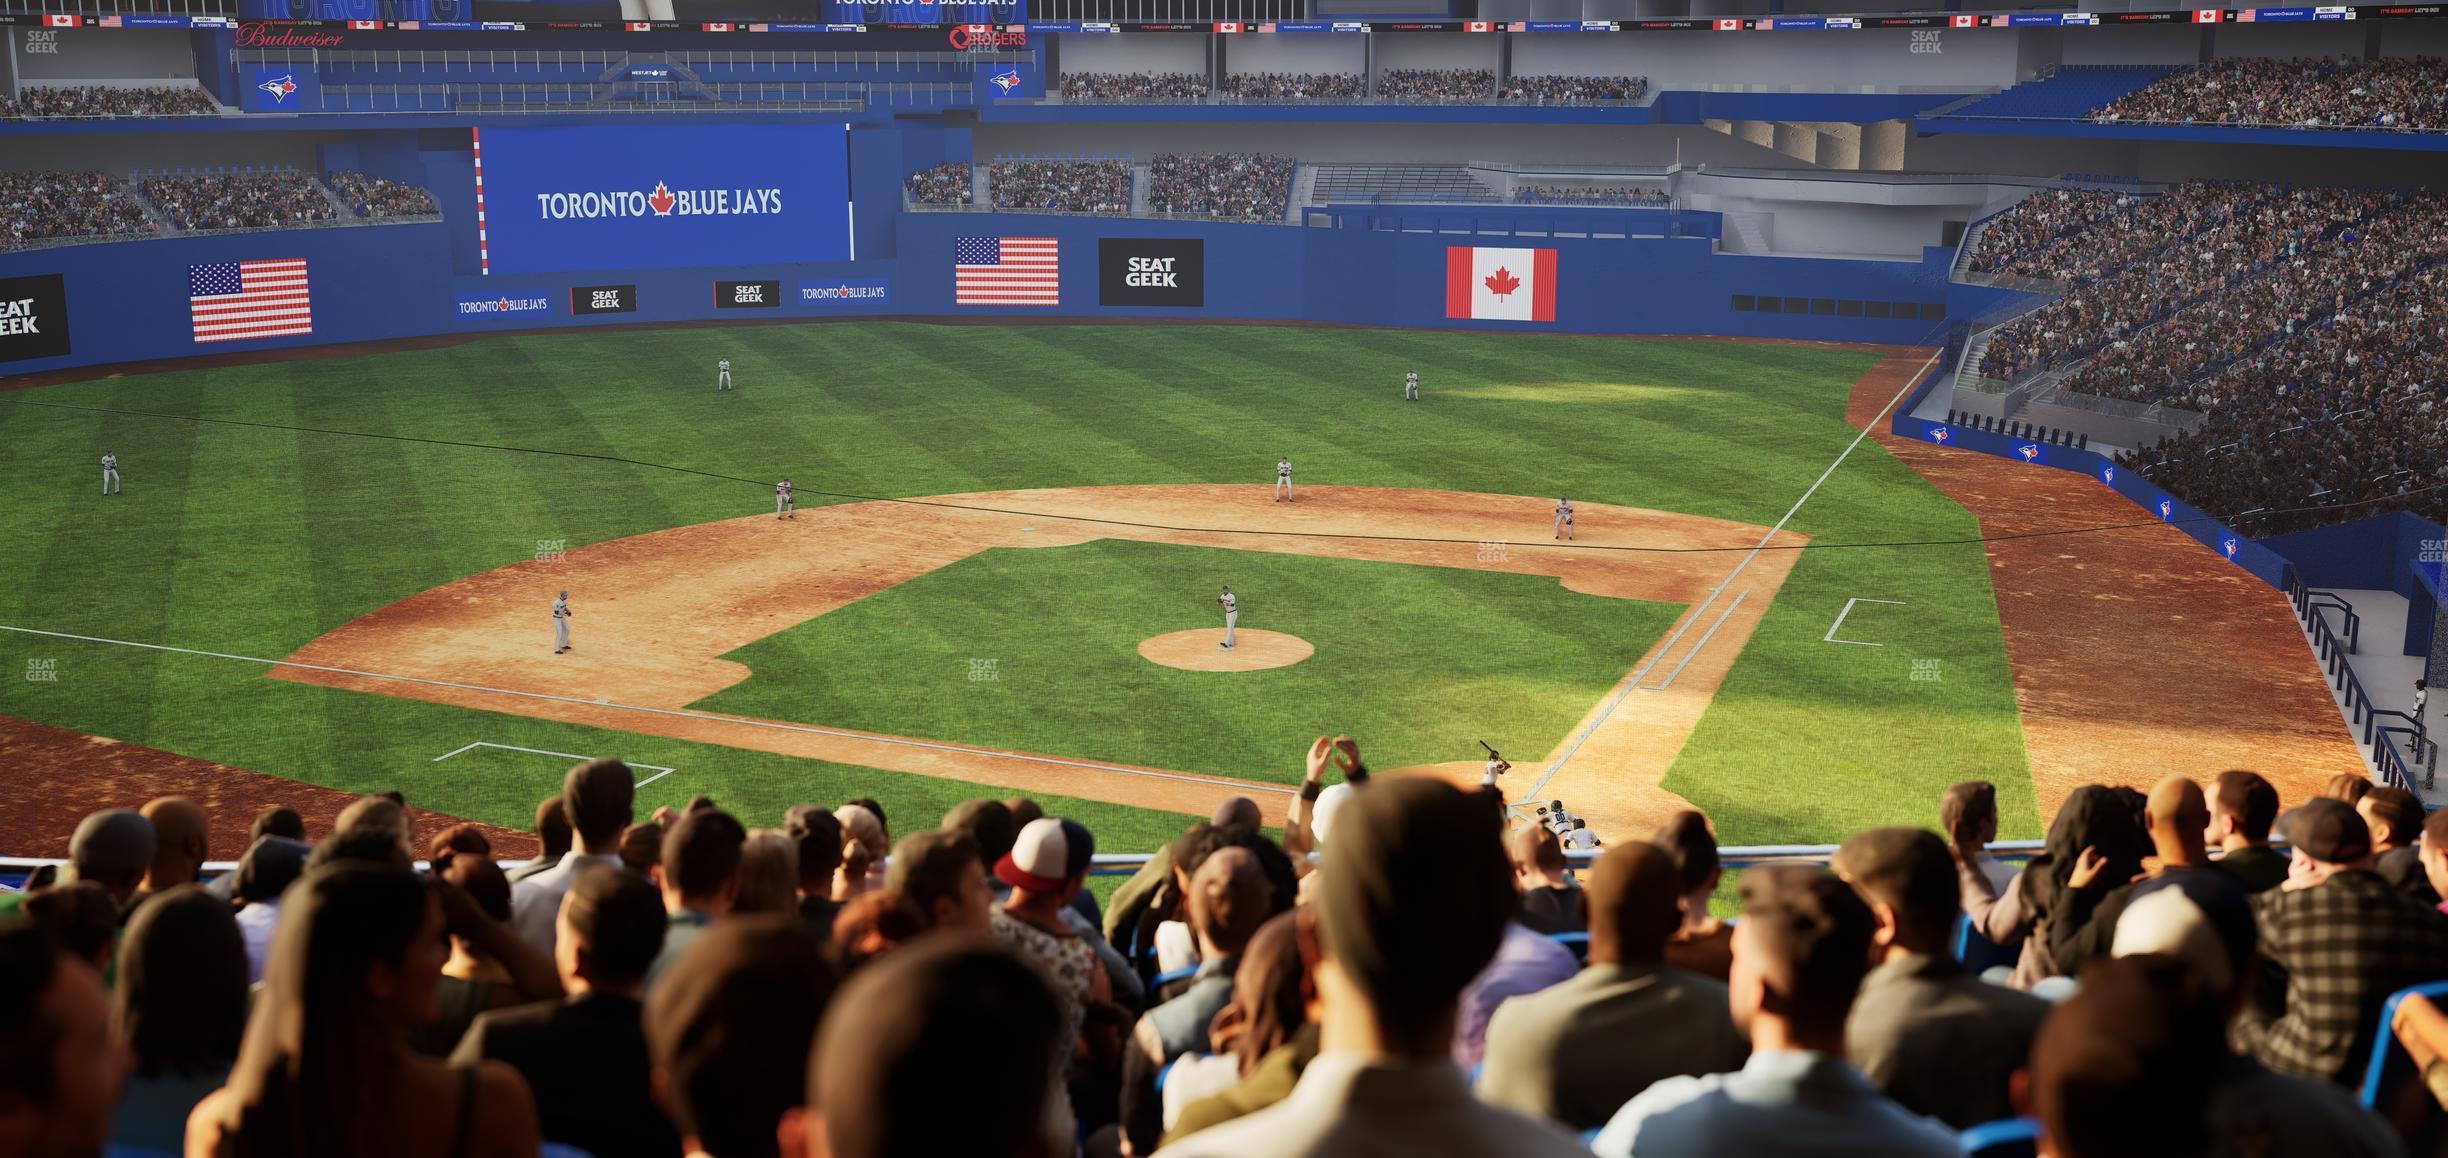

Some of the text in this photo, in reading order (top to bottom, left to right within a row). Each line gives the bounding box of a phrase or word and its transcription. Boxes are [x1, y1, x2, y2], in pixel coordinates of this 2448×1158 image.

[236, 22, 344, 47] Budweiser
[973, 33, 1026, 45] ROGERS
[538, 188, 782, 219] TORONTO BLUE JAYS
[1128, 257, 1175, 272] SEAT
[1125, 272, 1178, 288] GEEK
[593, 290, 618, 300] SEAT
[736, 285, 762, 294] SEAT
[802, 287, 884, 299] TORONTO BLUE JAYS
[460, 298, 547, 314] TORONTO BLUE JAYS
[592, 299, 620, 309] GEEK
[735, 294, 763, 303] GEEK
[0, 298, 34, 318] EAT
[0, 315, 40, 336] EEK
